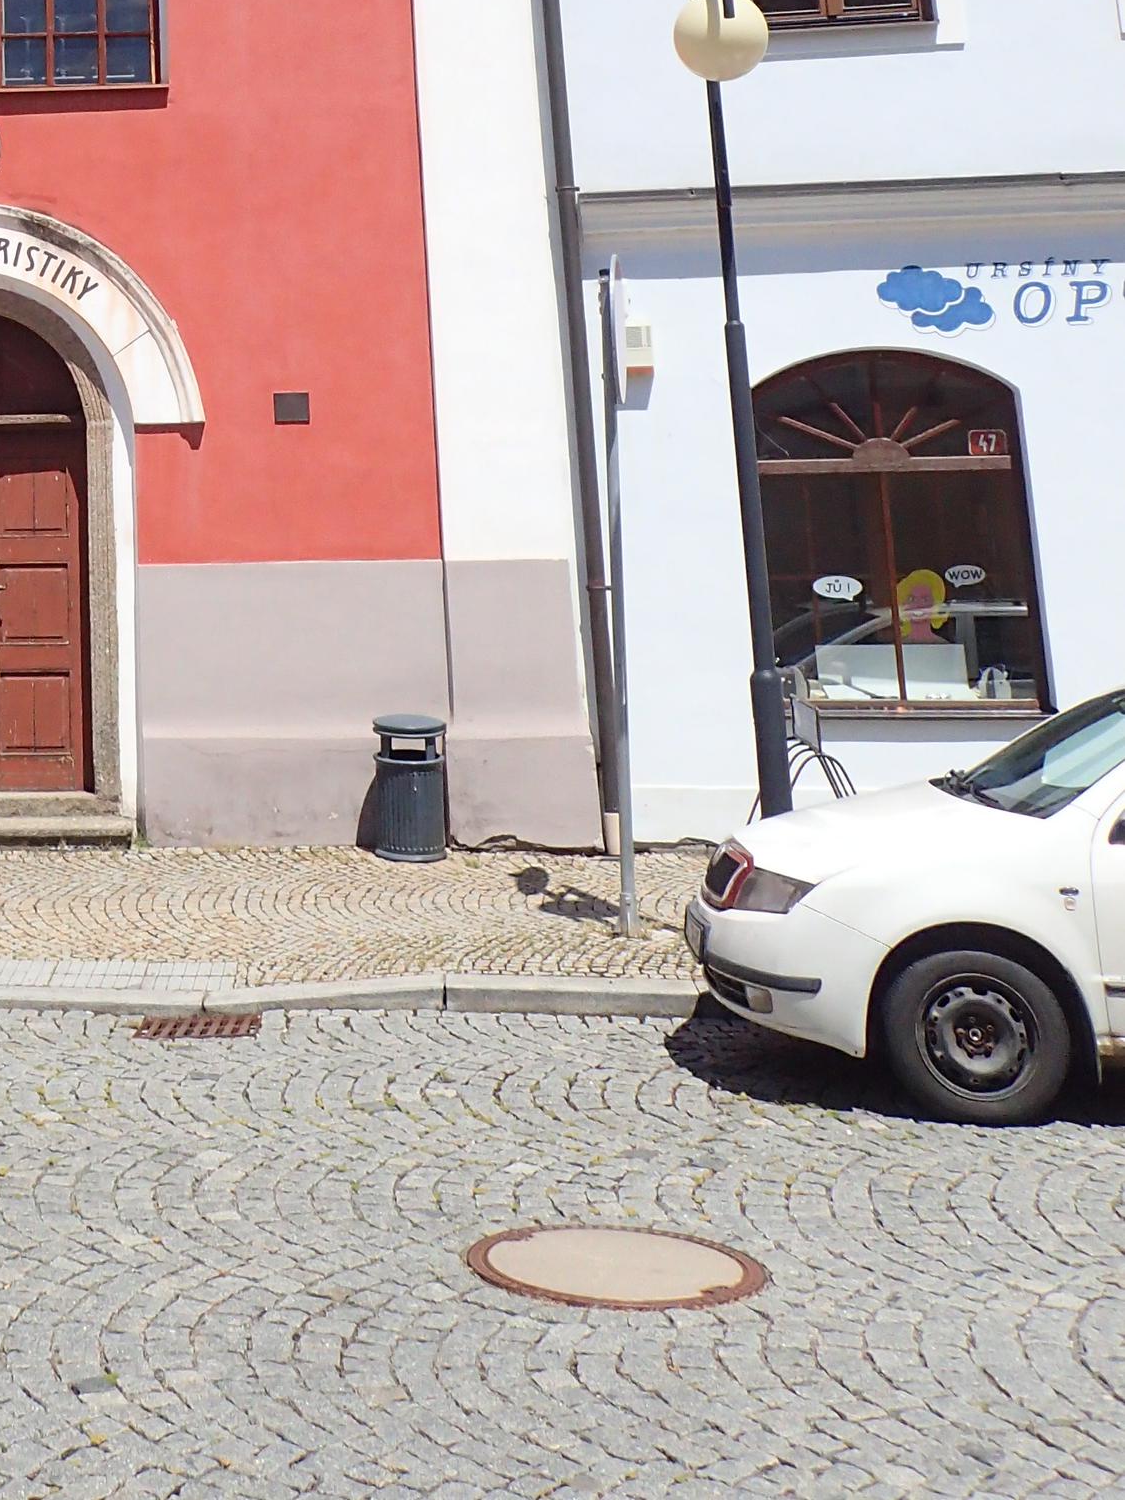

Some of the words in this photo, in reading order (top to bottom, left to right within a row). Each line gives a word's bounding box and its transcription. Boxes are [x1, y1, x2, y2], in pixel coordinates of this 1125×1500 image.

[965, 257, 1111, 279] URSÍNY
[978, 434, 996, 453] 47
[947, 569, 983, 580] WOW
